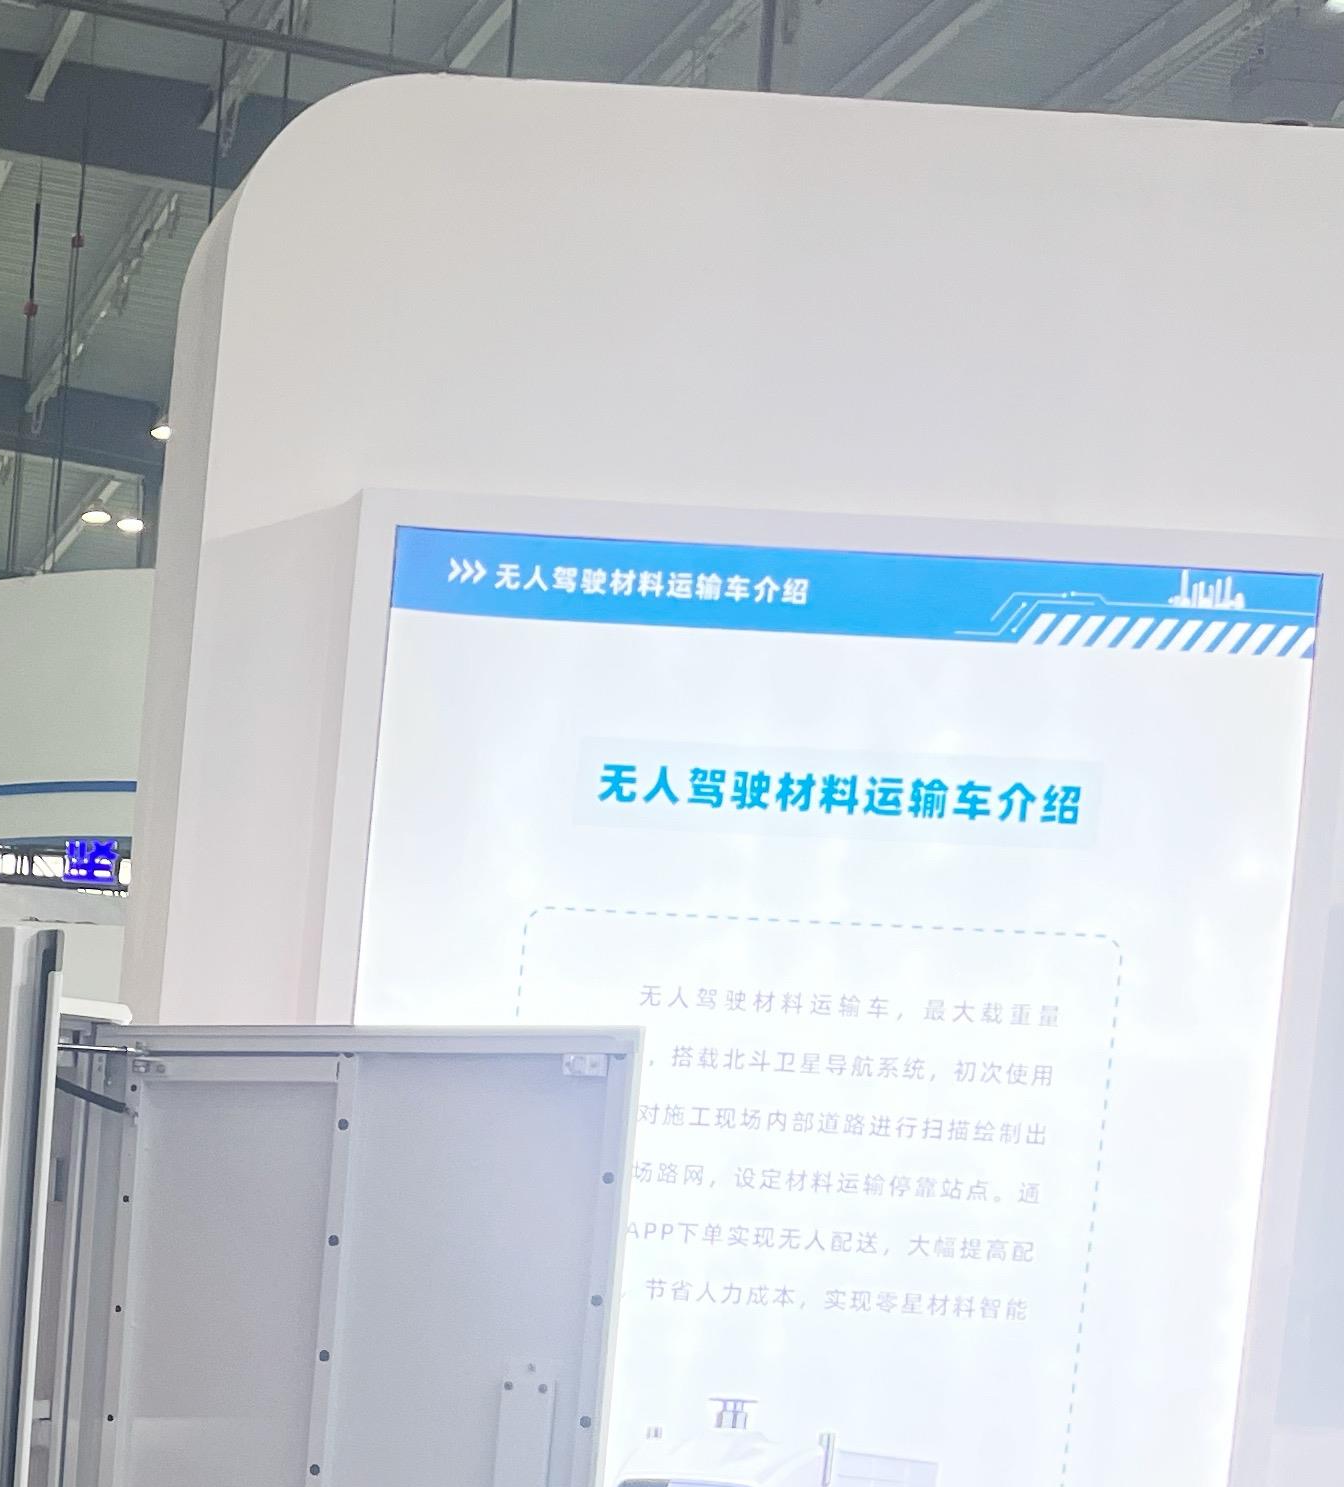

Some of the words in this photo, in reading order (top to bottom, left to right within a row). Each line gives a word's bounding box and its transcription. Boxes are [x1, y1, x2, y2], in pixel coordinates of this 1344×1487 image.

[495, 561, 810, 605] 无人驾驶材料运输车介绍
[597, 762, 1084, 826] 无人驾驶材料运输车介绍
[639, 984, 1062, 1030] 无人驾驶材料运输车，最大载重量
